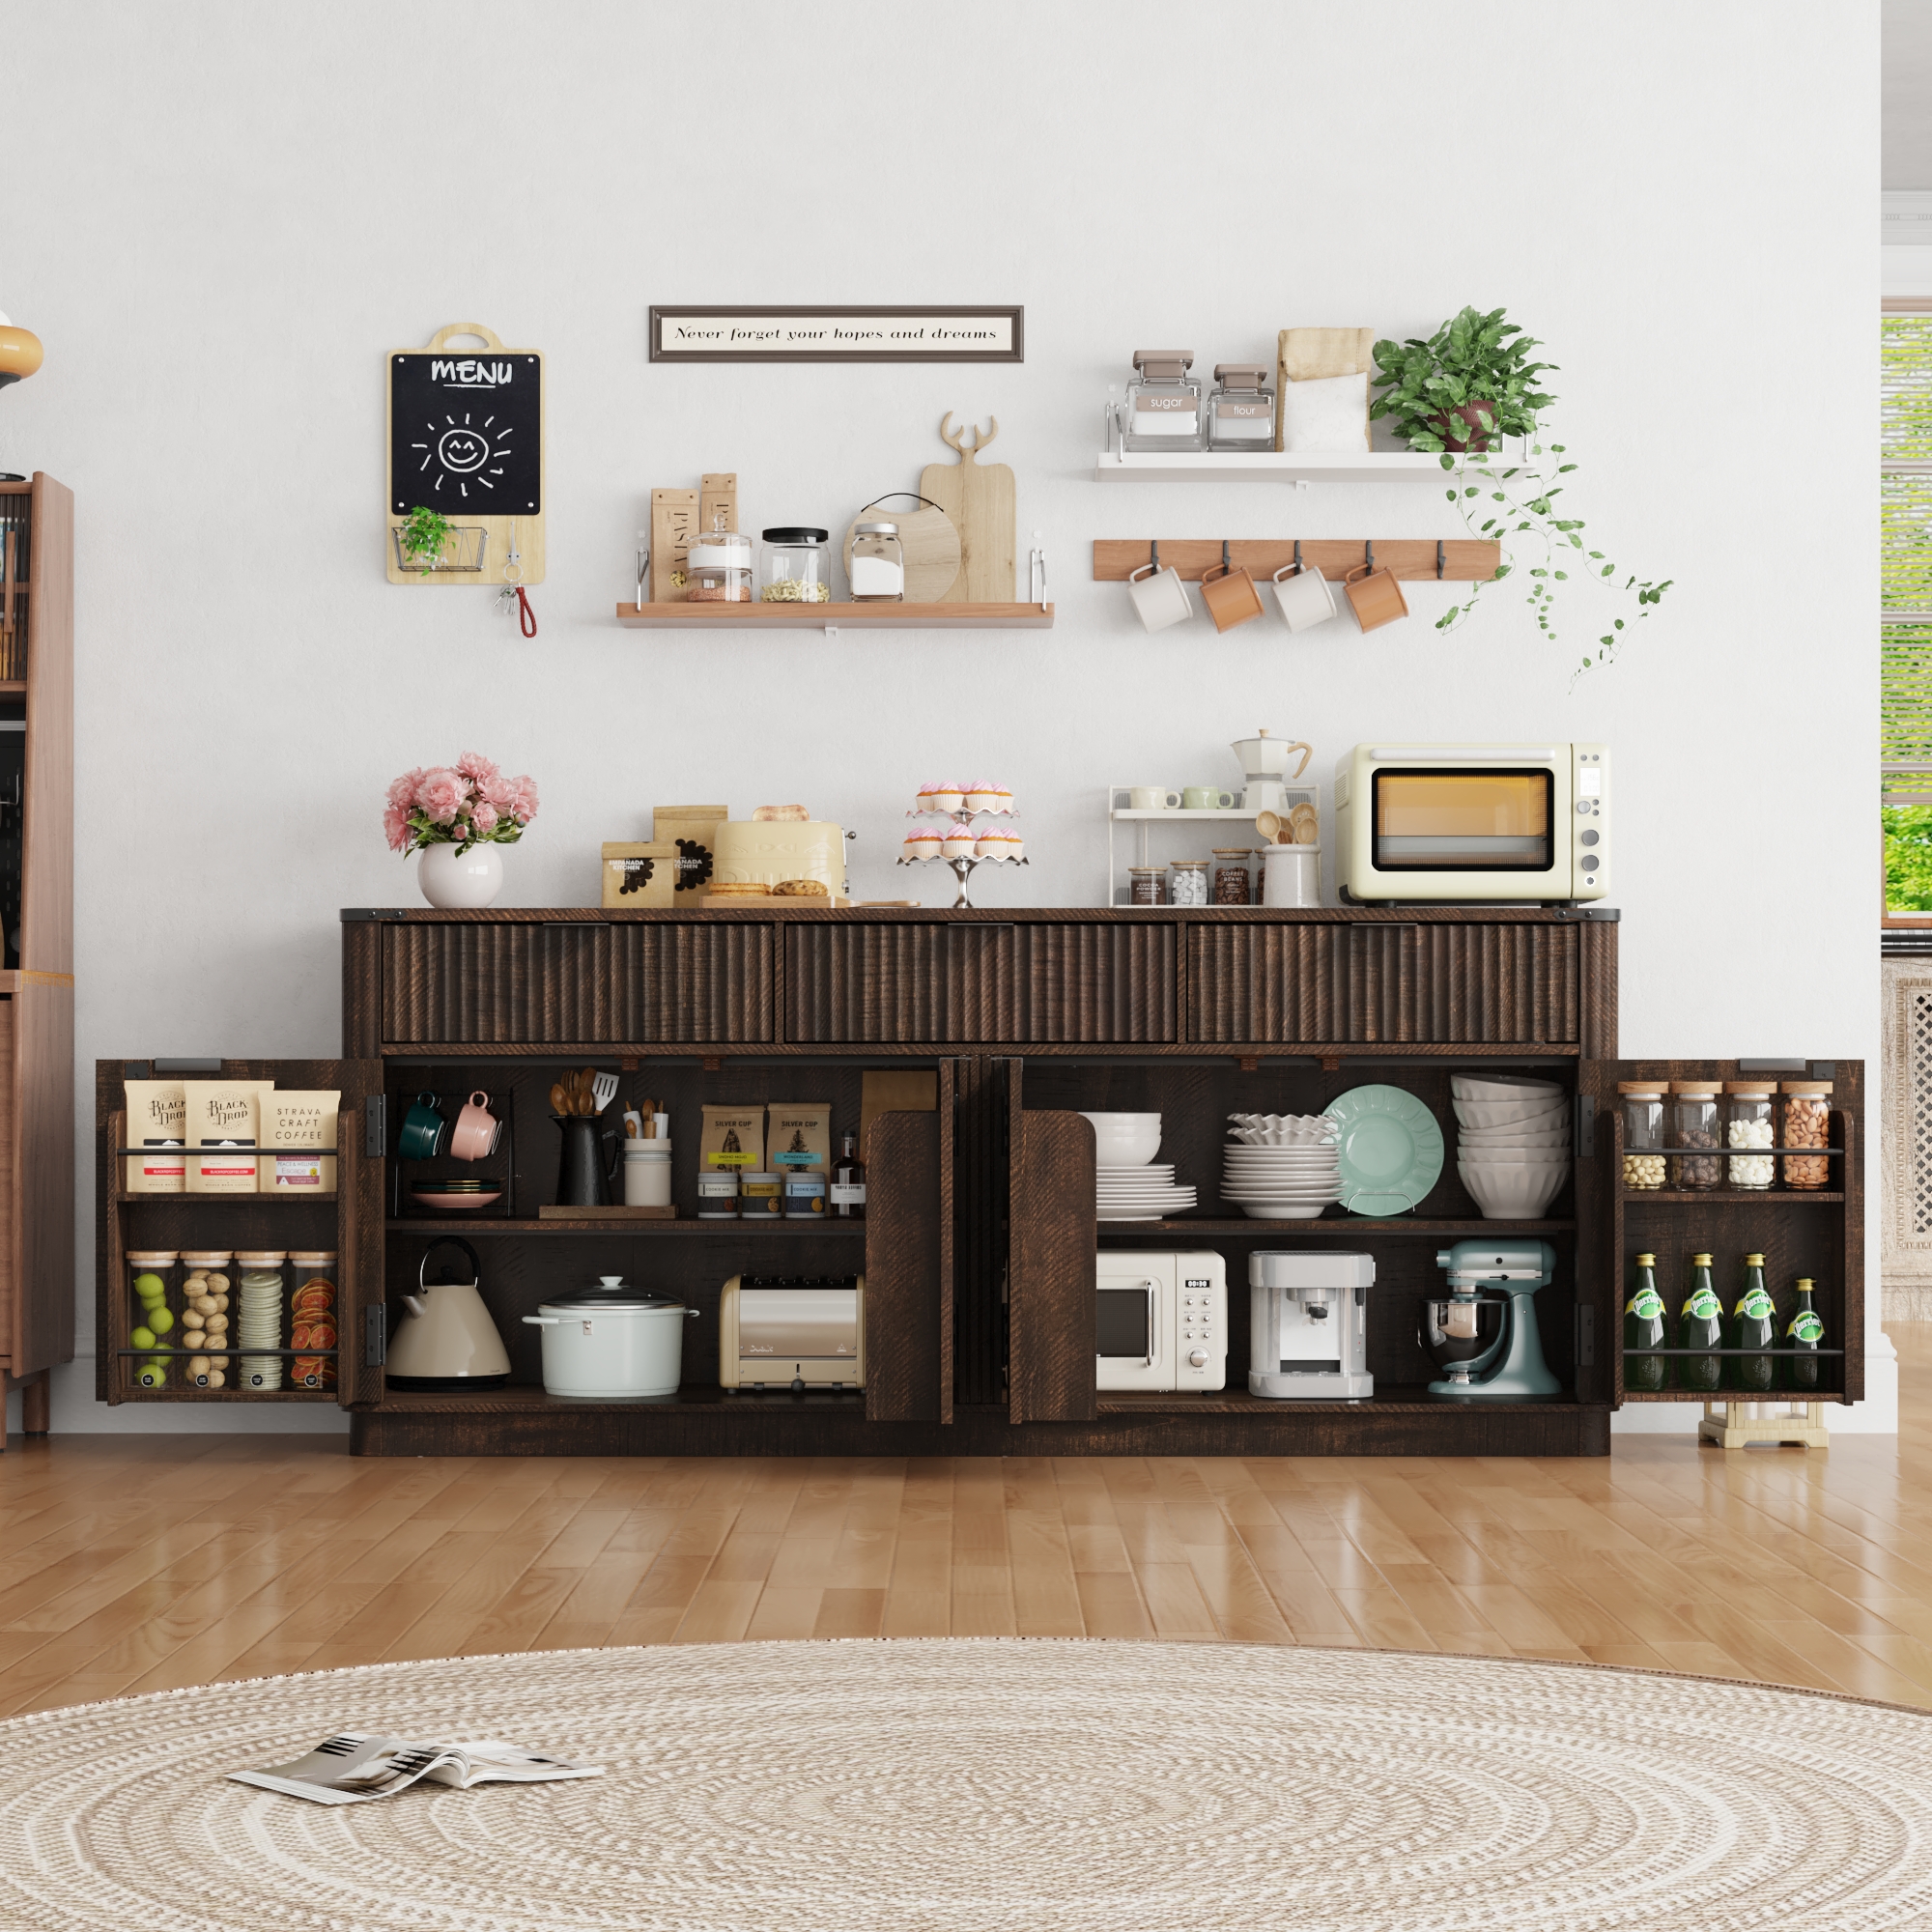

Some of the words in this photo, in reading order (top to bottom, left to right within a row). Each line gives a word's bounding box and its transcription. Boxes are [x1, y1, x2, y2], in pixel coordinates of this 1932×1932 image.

[674, 326, 724, 340] Never
[729, 327, 781, 342] forget
[786, 330, 827, 342] your
[834, 327, 883, 342] hopes
[891, 327, 923, 340] and
[931, 327, 997, 340] dreams
[431, 359, 513, 384] MENU
[1150, 397, 1183, 410] sugar
[1233, 405, 1256, 415] flour
[208, 1099, 247, 1117] BLACK
[216, 1110, 248, 1125] DROP
[279, 1119, 319, 1127] CRAFT
[275, 1130, 322, 1140] COFFEE
[1634, 1293, 1660, 1316] Perrier
[1691, 1293, 1718, 1316] Perrier
[1745, 1293, 1771, 1316] Perrier
[1794, 1316, 1820, 1339] Perrier
